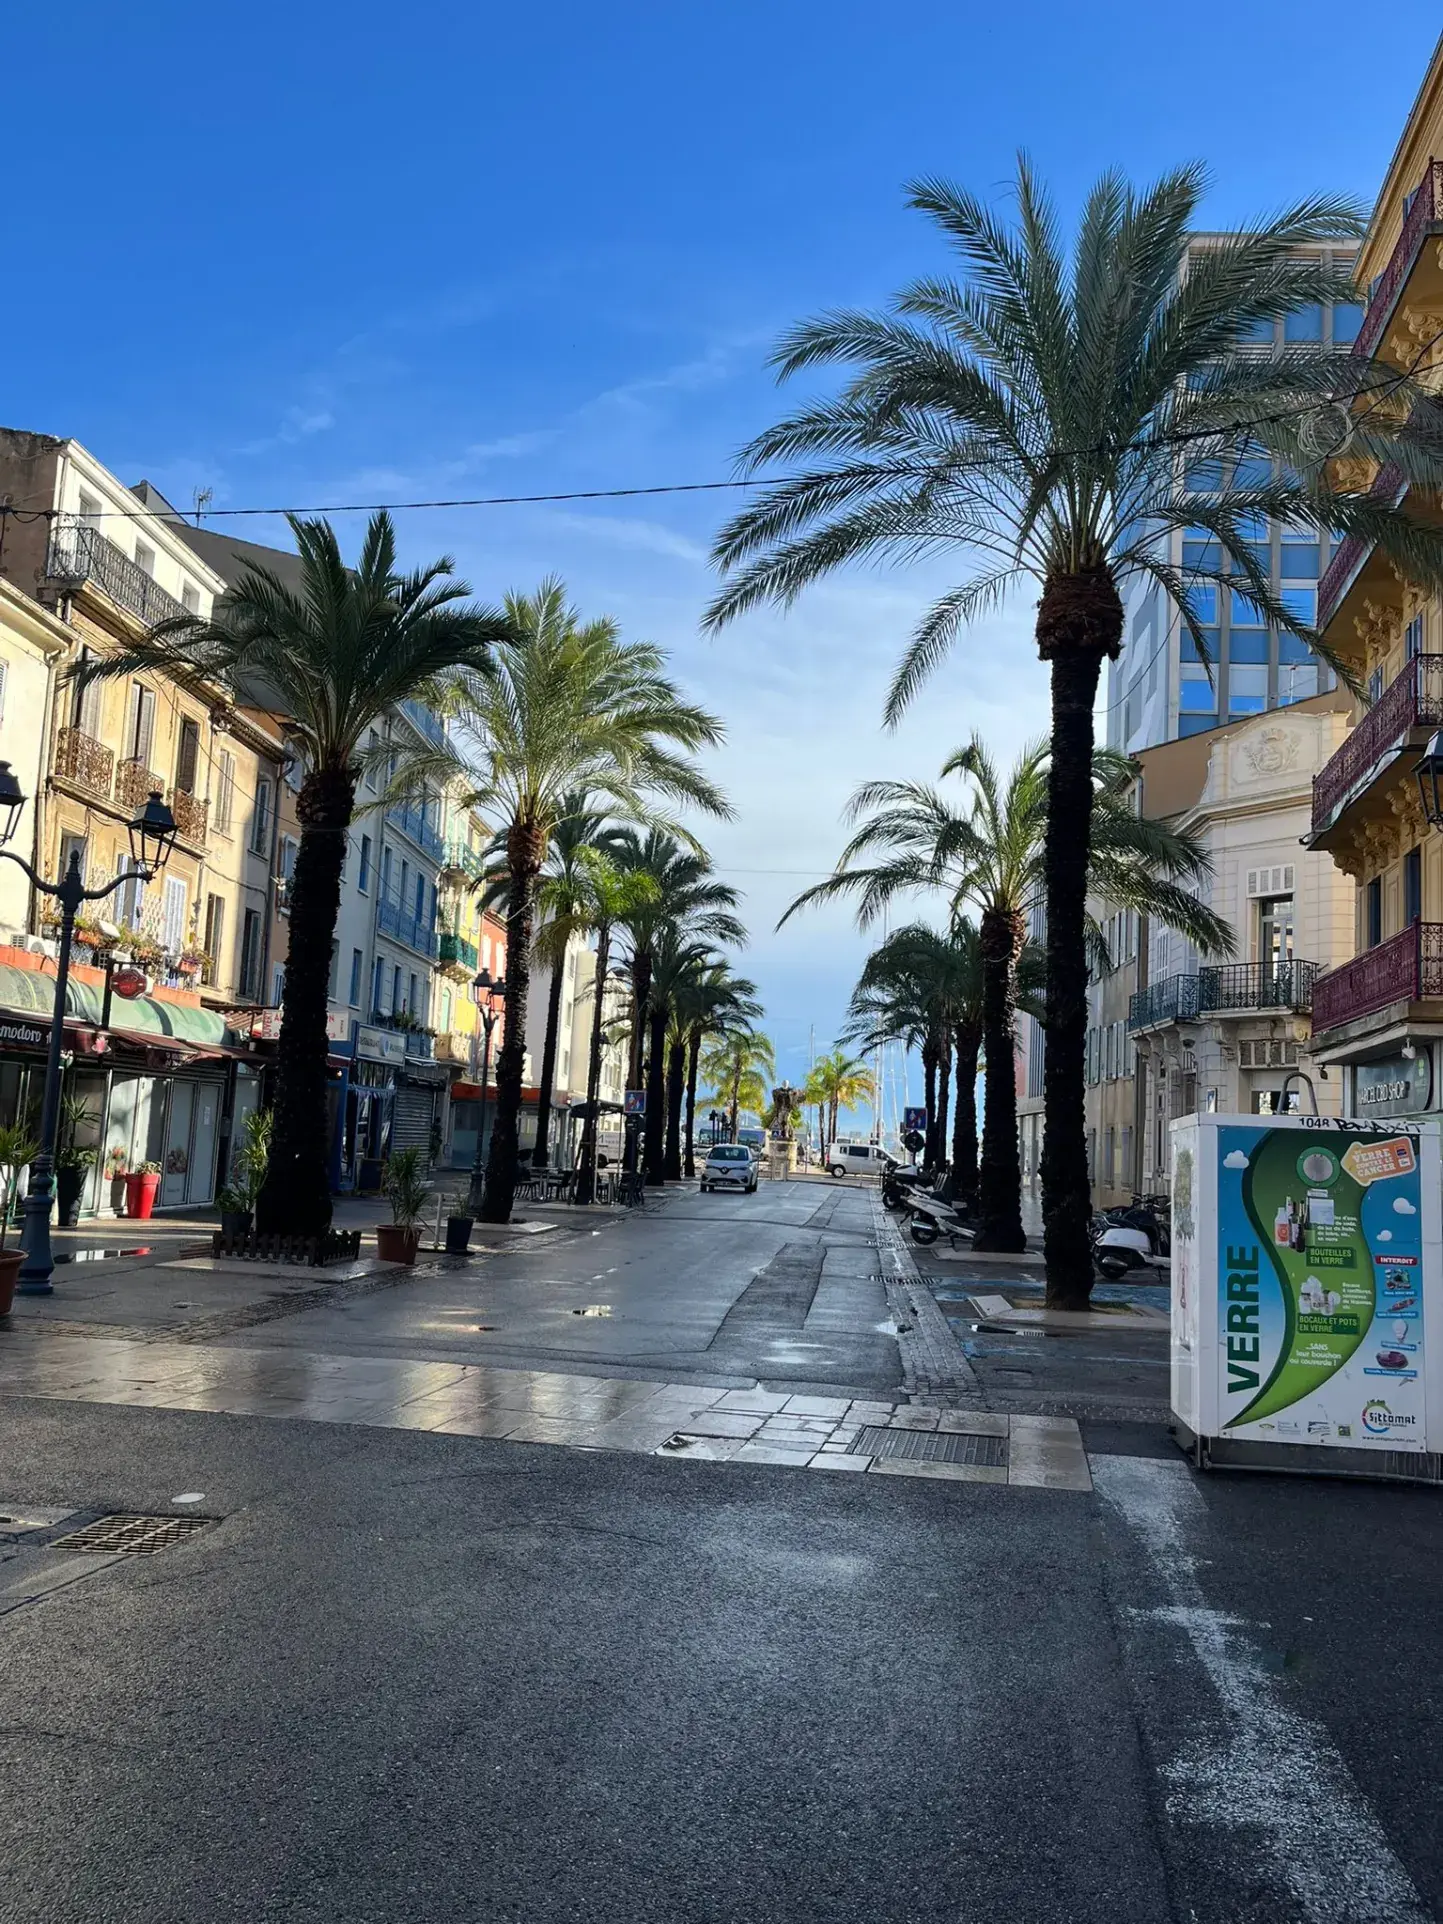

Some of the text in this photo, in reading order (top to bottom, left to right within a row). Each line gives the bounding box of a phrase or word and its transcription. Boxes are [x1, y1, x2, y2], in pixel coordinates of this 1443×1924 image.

[1357, 1163, 1396, 1177] CANCER
[1310, 1248, 1351, 1257] BOUTEILLES
[1310, 1256, 1344, 1265] EN VERRE
[1380, 1256, 1413, 1264] INTERDIT
[1227, 1245, 1259, 1393] VERRE
[1300, 1315, 1357, 1326] BOCAUX ET POTS
[1300, 1324, 1333, 1333] EN VERRE
[1311, 1350, 1341, 1359] bouchon
